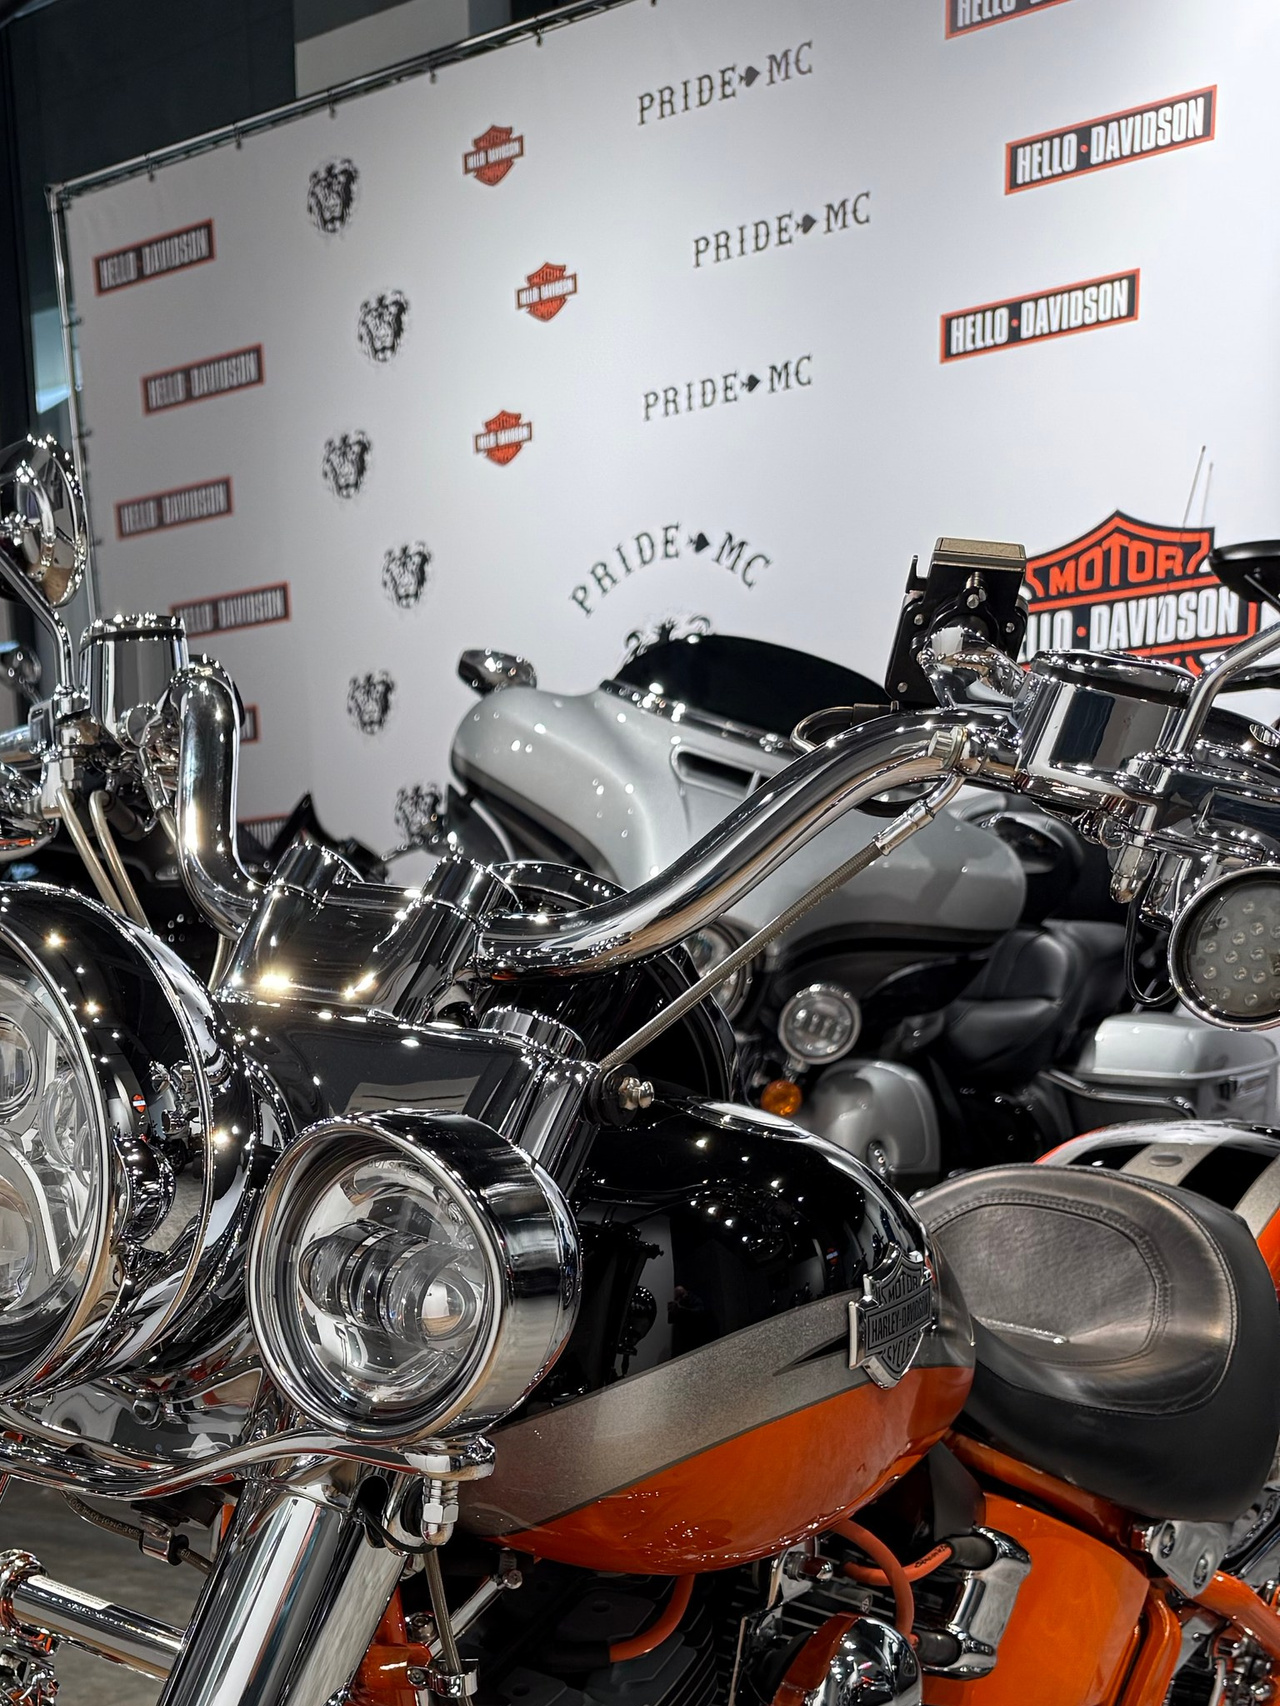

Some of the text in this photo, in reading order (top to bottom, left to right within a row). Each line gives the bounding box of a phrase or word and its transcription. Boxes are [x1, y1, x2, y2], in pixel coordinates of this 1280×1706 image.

[637, 40, 815, 126] PRIDE MC
[1015, 96, 1205, 185] HELLO DAVIDSON
[692, 191, 872, 269] PRIDE MC
[949, 279, 1129, 356] HELLO DAVIDSON
[643, 354, 814, 422] PRIDE MC
[569, 522, 773, 619] PRIDE MC
[1048, 531, 1185, 597] MOTOR
[1089, 584, 1240, 652] DAVIDSON
[871, 1292, 929, 1344] HARLEY-DAVIDSON
[887, 1272, 918, 1303] MOTOR
[886, 1331, 918, 1368] CYCLES
